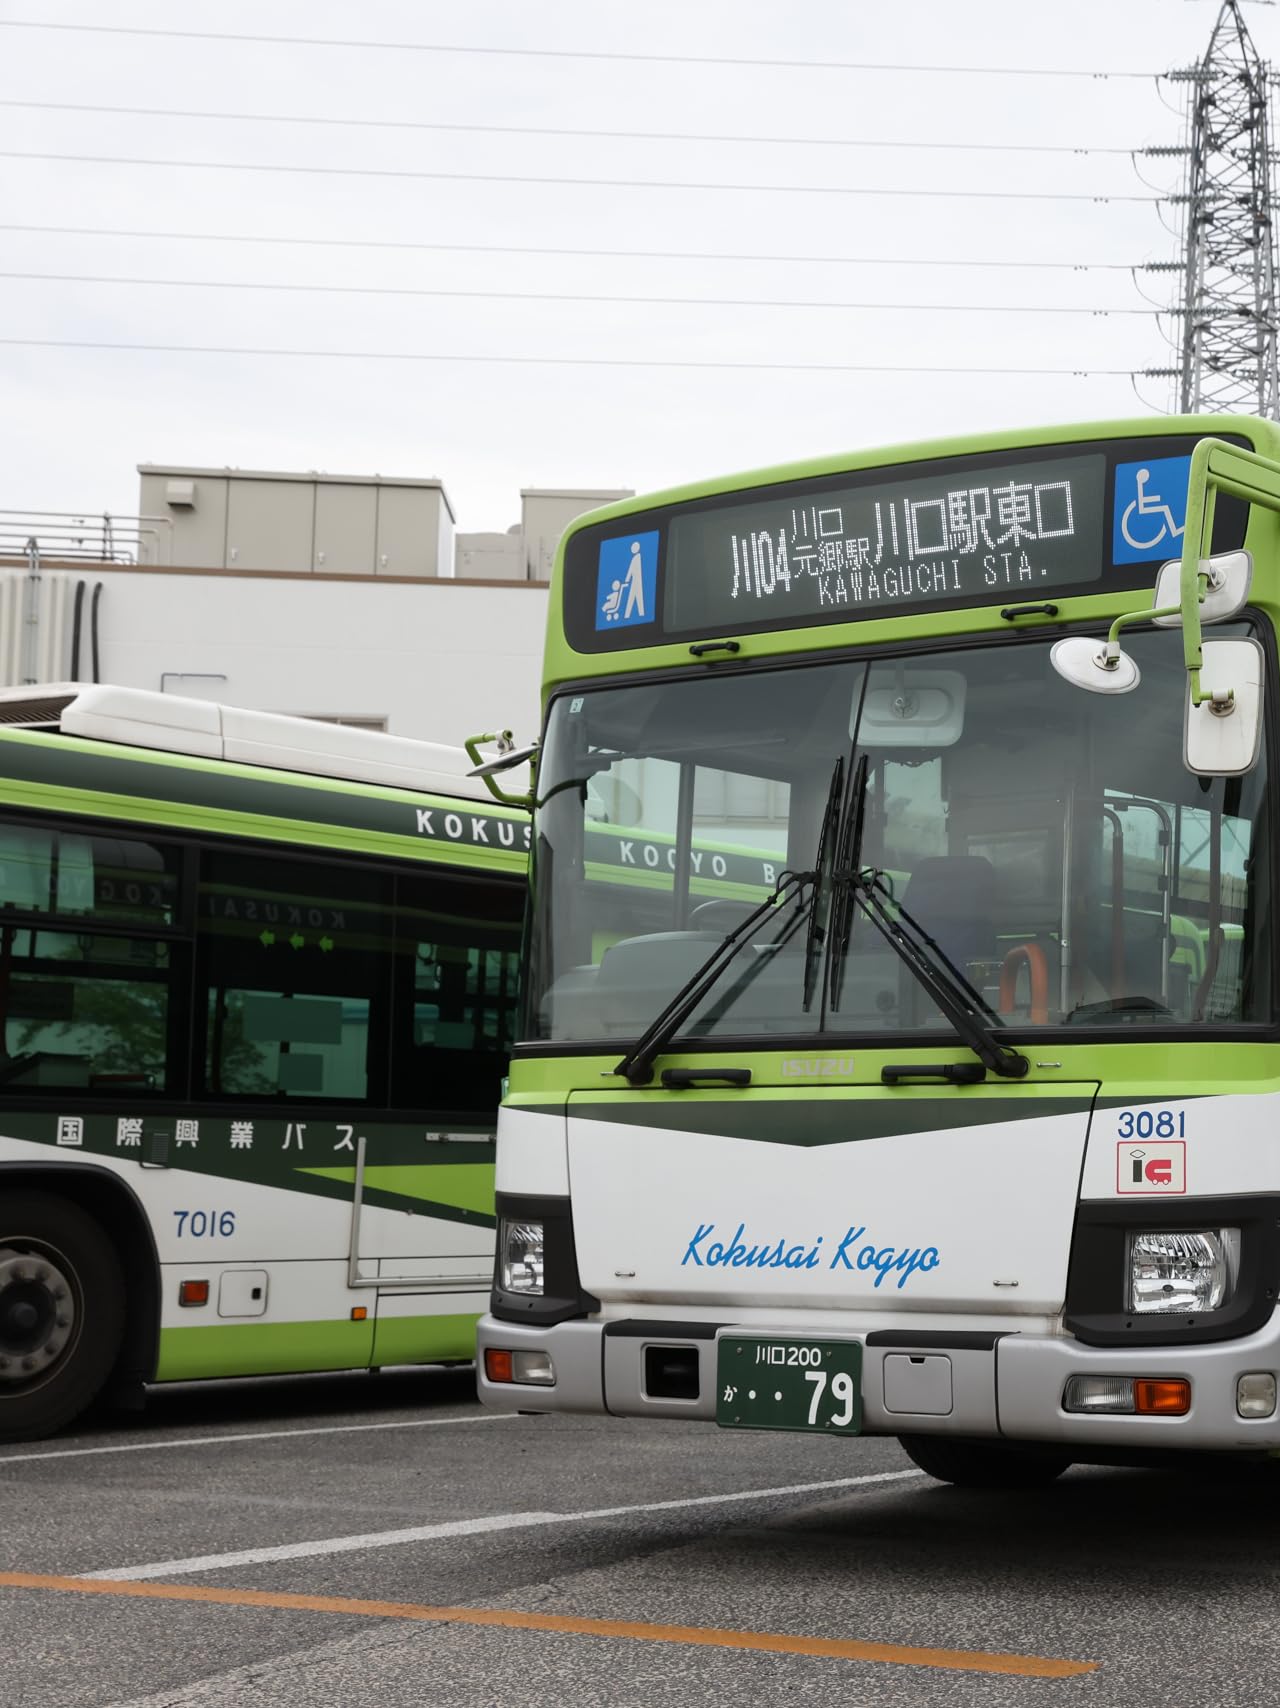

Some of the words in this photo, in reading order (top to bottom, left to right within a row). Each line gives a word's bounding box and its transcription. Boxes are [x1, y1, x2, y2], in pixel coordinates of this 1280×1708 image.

[874, 480, 1075, 565] 川口駅東口
[819, 559, 960, 605] KAWAGUCHI
[984, 551, 1047, 585] STA.
[783, 1056, 854, 1076] ISUZU
[56, 1116, 355, 1151] 国際興業バス
[1118, 1111, 1184, 1138] 3081
[173, 1211, 236, 1238] 7016
[681, 1223, 823, 1269] Kokusai
[829, 1227, 940, 1289] Kogyo
